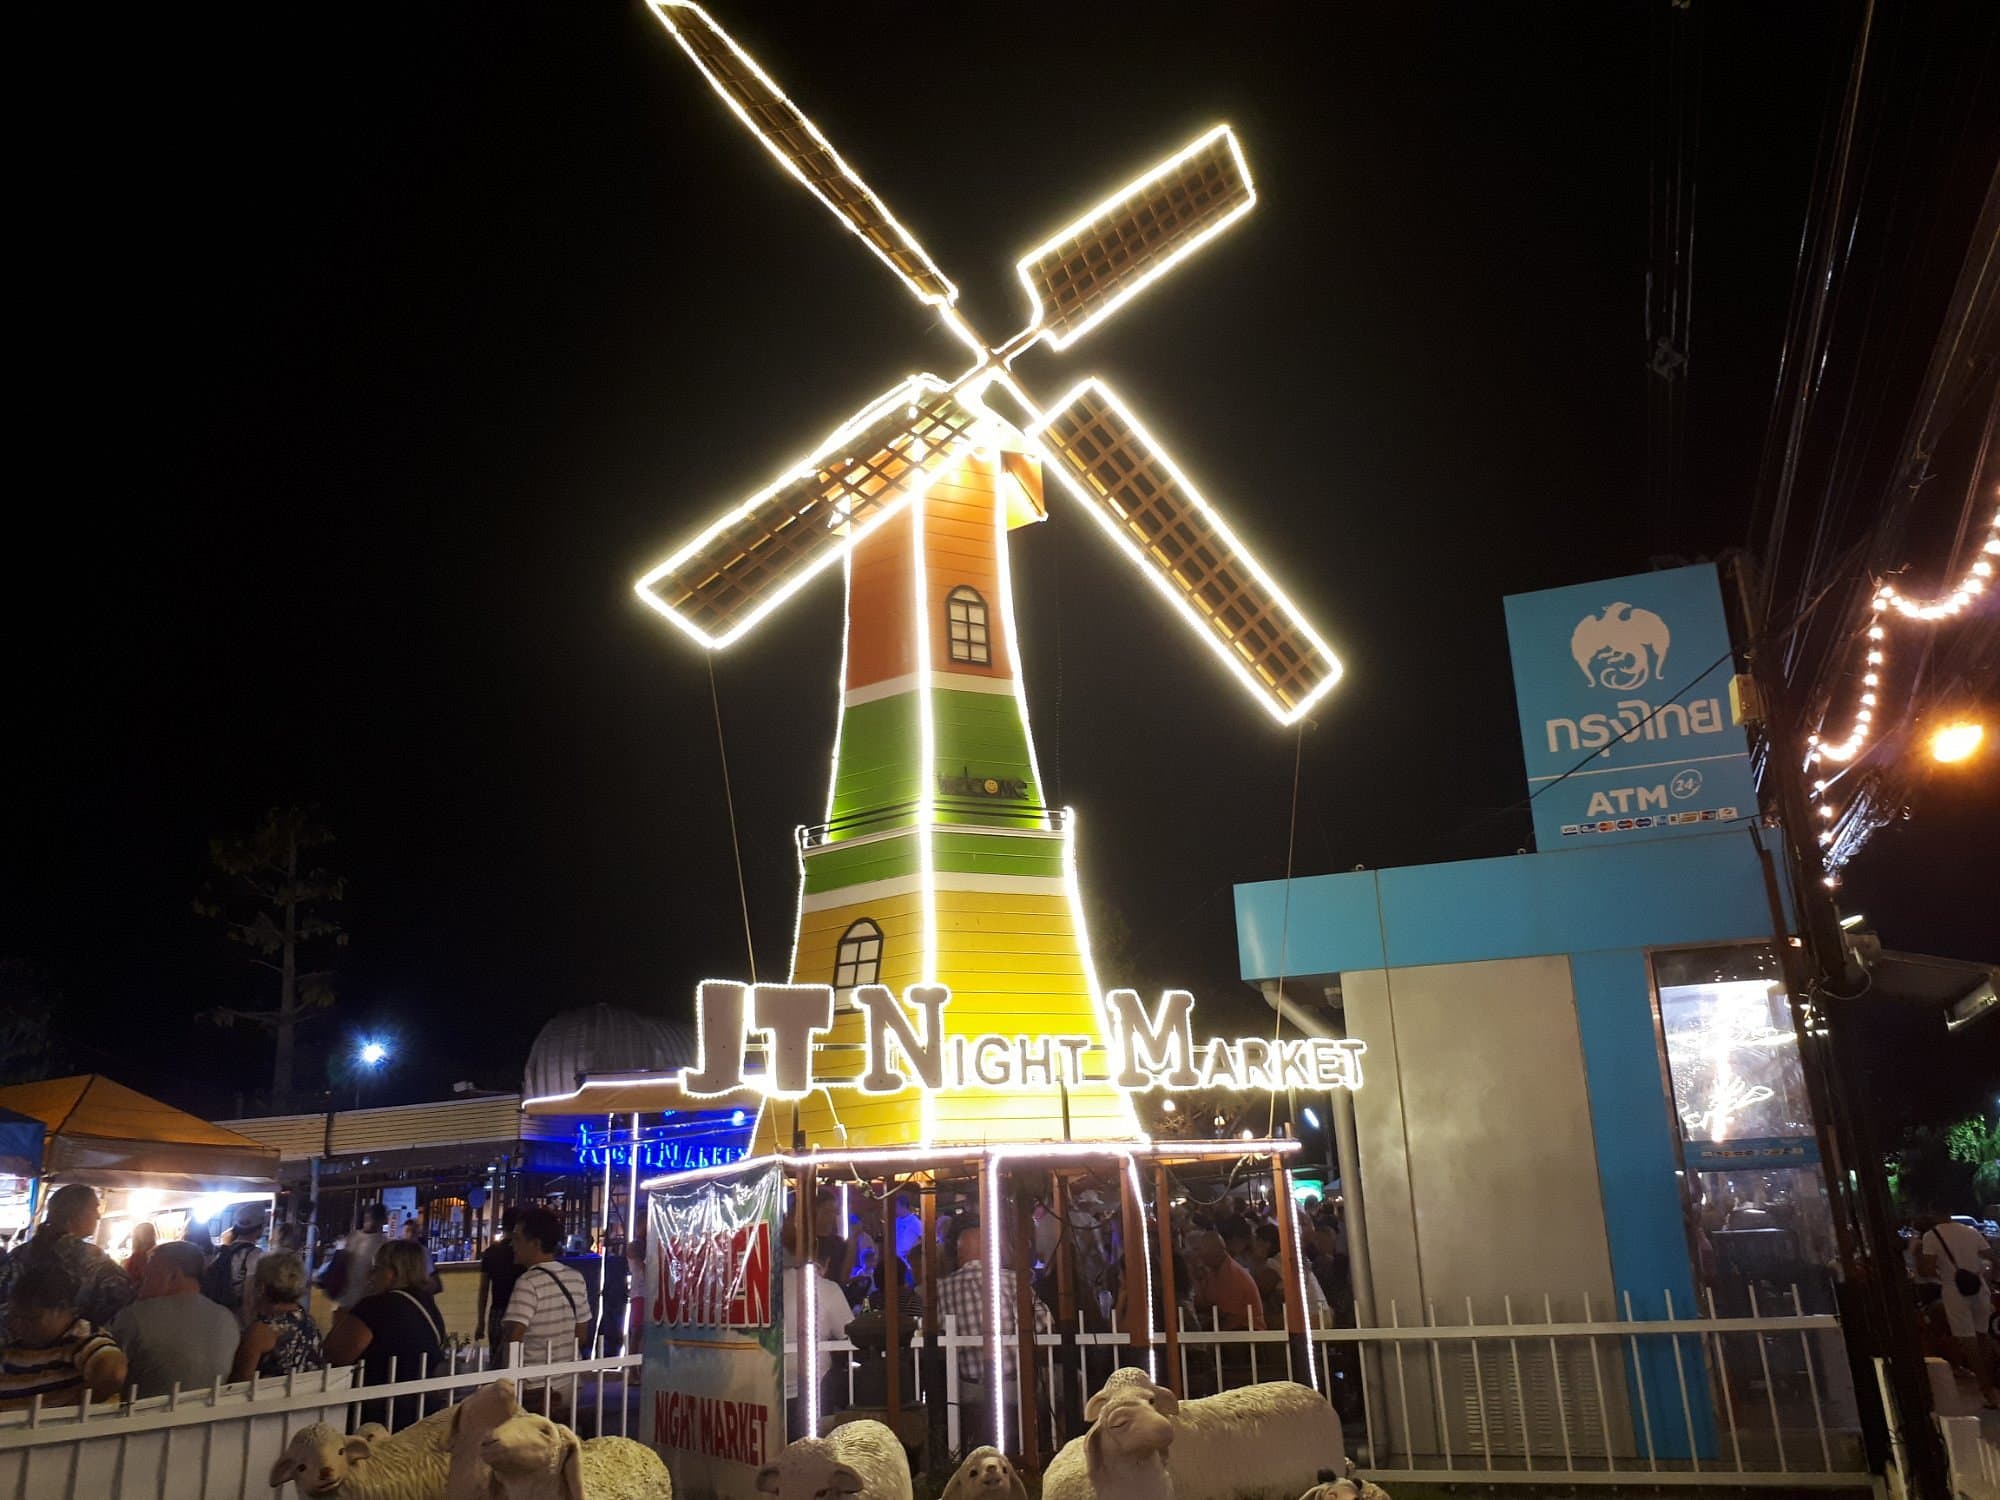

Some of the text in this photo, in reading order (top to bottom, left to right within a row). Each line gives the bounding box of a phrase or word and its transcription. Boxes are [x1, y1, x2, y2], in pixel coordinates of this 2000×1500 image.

[1546, 698, 1723, 757] กรุงไทย
[1586, 784, 1669, 817] ATM
[682, 982, 1367, 1096] JT NIGHT MARKET
[655, 1390, 768, 1466] NIGHT MARKET
